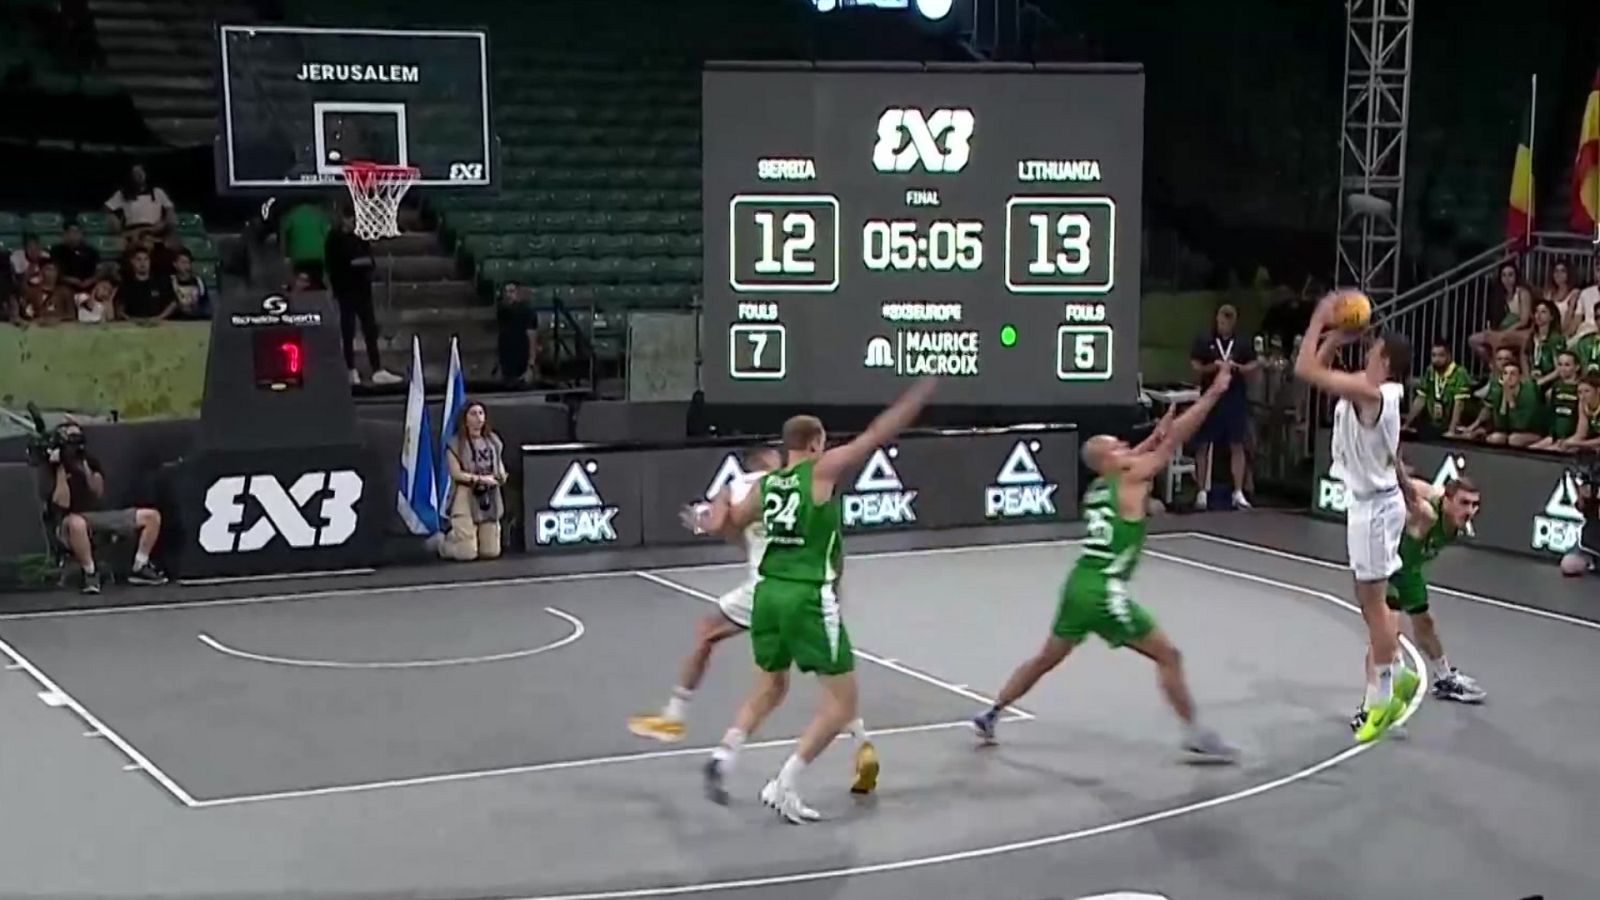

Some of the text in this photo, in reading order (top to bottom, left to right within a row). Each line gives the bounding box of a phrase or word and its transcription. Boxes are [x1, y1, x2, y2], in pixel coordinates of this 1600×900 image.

[297, 64, 419, 82] JERUSALEM
[757, 159, 816, 179] SERBIA
[1018, 160, 1101, 181] LITHUANIA
[906, 191, 940, 205] FINAL
[754, 212, 816, 272] 12
[863, 221, 983, 269] 05:05
[1029, 214, 1091, 273] 13
[738, 303, 778, 320] FOULS
[1065, 304, 1106, 321] FOULS
[748, 333, 768, 368] 7
[906, 331, 979, 351] MAURICE
[1073, 335, 1095, 369] 5
[282, 343, 299, 373] 7
[906, 352, 978, 375] LACROIX
[763, 492, 801, 531] 24
[844, 489, 918, 526] PEAK
[986, 484, 1058, 517] PEAK
[536, 508, 618, 544] PEAK
